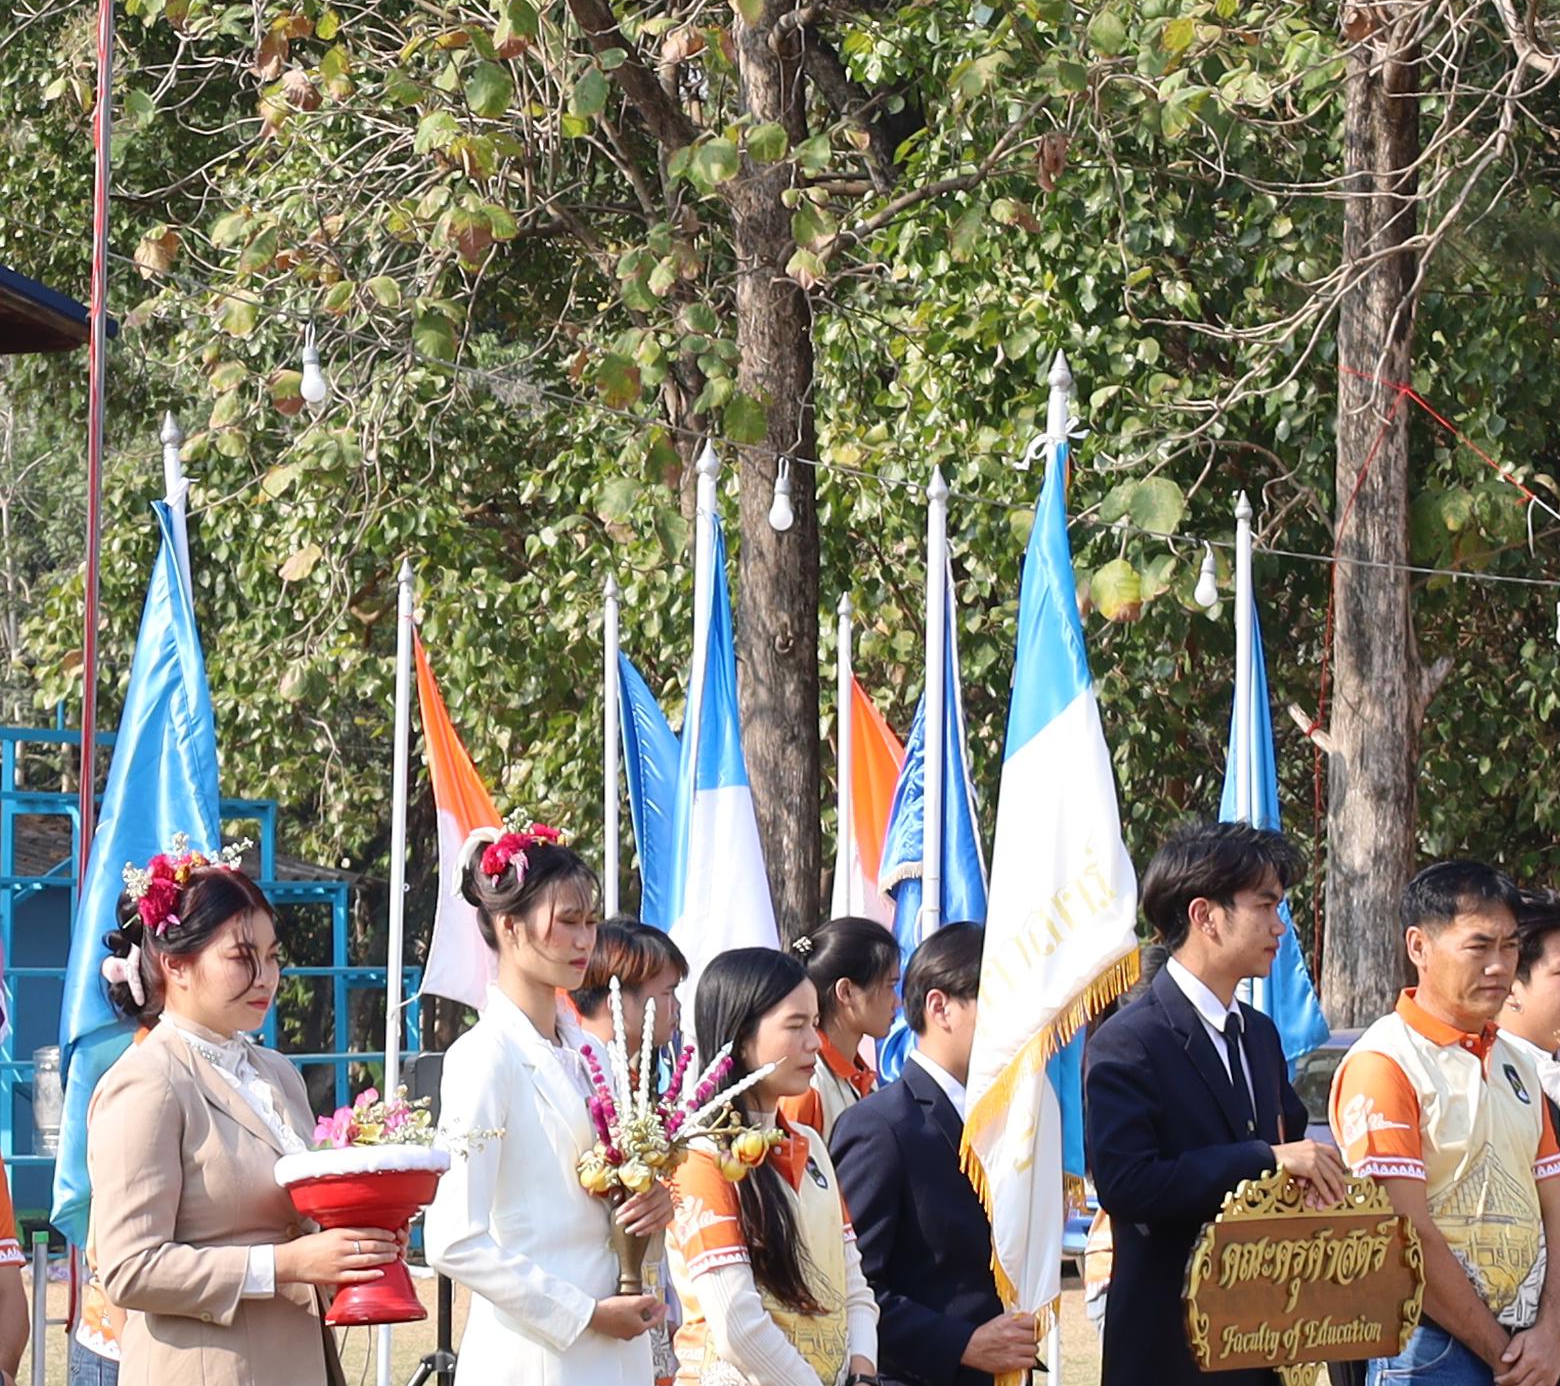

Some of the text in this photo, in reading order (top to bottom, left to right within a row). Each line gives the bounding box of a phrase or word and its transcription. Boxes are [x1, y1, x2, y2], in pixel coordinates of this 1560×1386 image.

[1218, 1215, 1399, 1313] คณะครุศาสตร์
[1220, 1315, 1382, 1360] Faculty of Education
